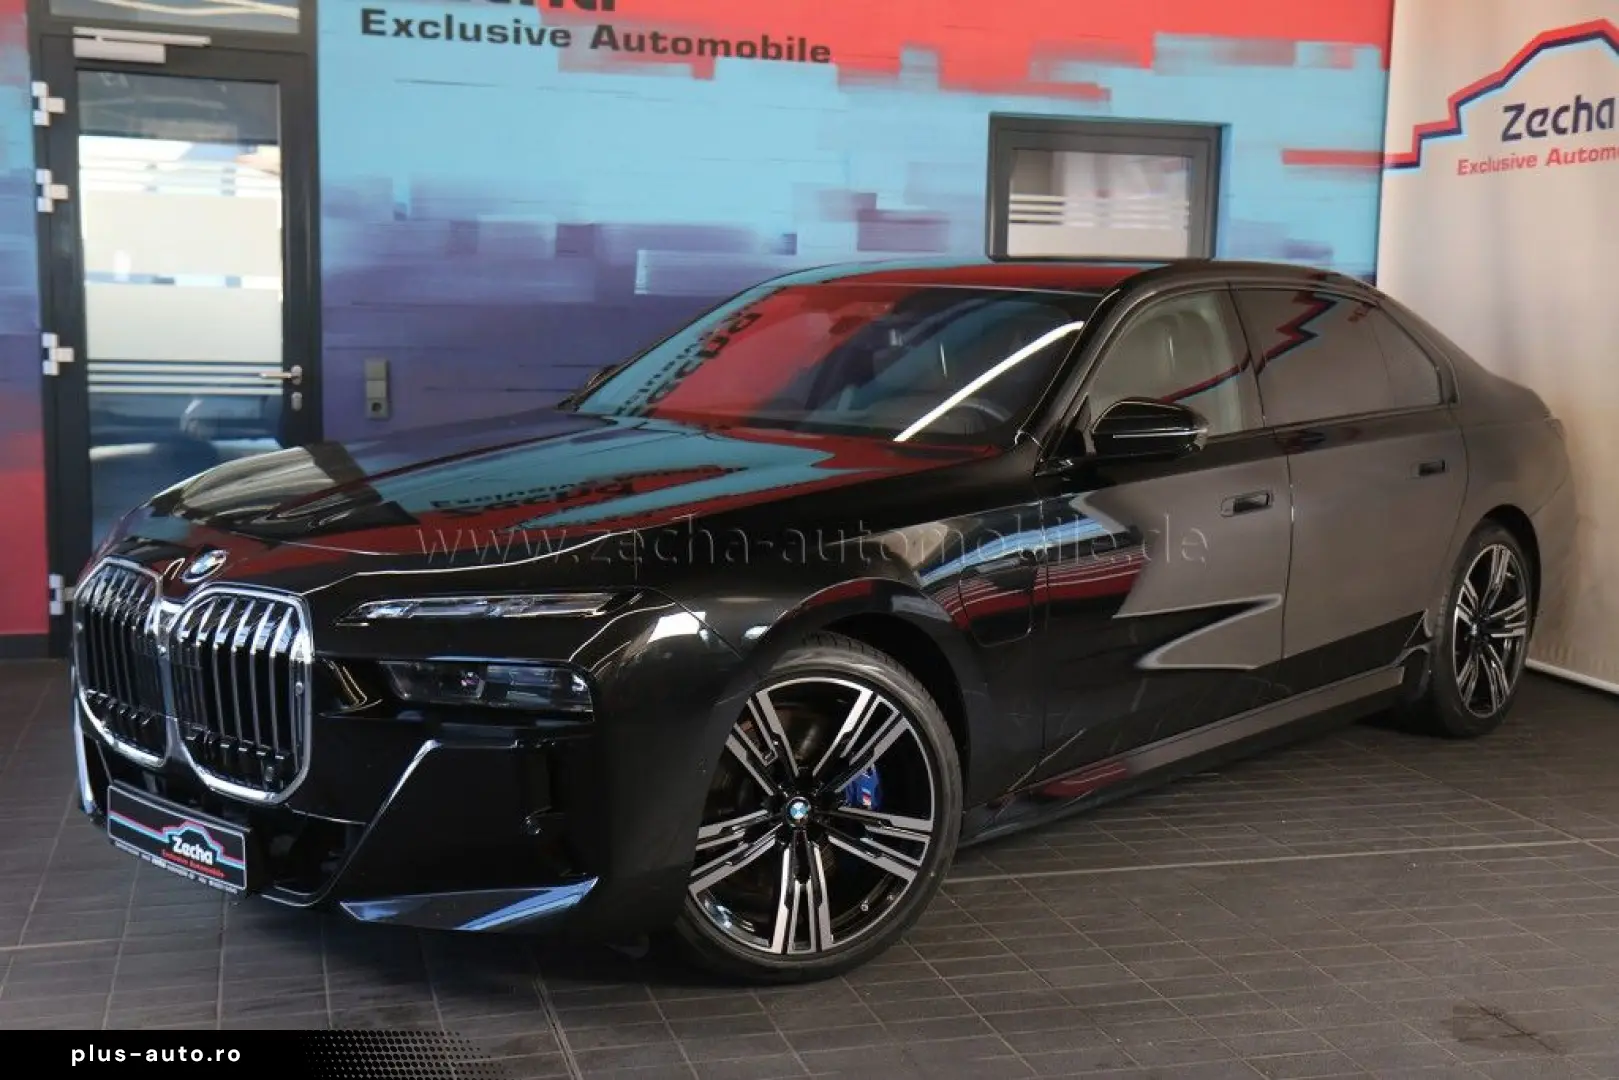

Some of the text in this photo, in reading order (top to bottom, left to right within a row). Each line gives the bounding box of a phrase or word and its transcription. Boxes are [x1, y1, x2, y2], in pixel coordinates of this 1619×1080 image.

[360, 8, 832, 64] Exclusive Automobile
[1501, 95, 1615, 142] Zecha
[1457, 153, 1538, 176] Exclusive
[172, 836, 213, 866] Zecha
